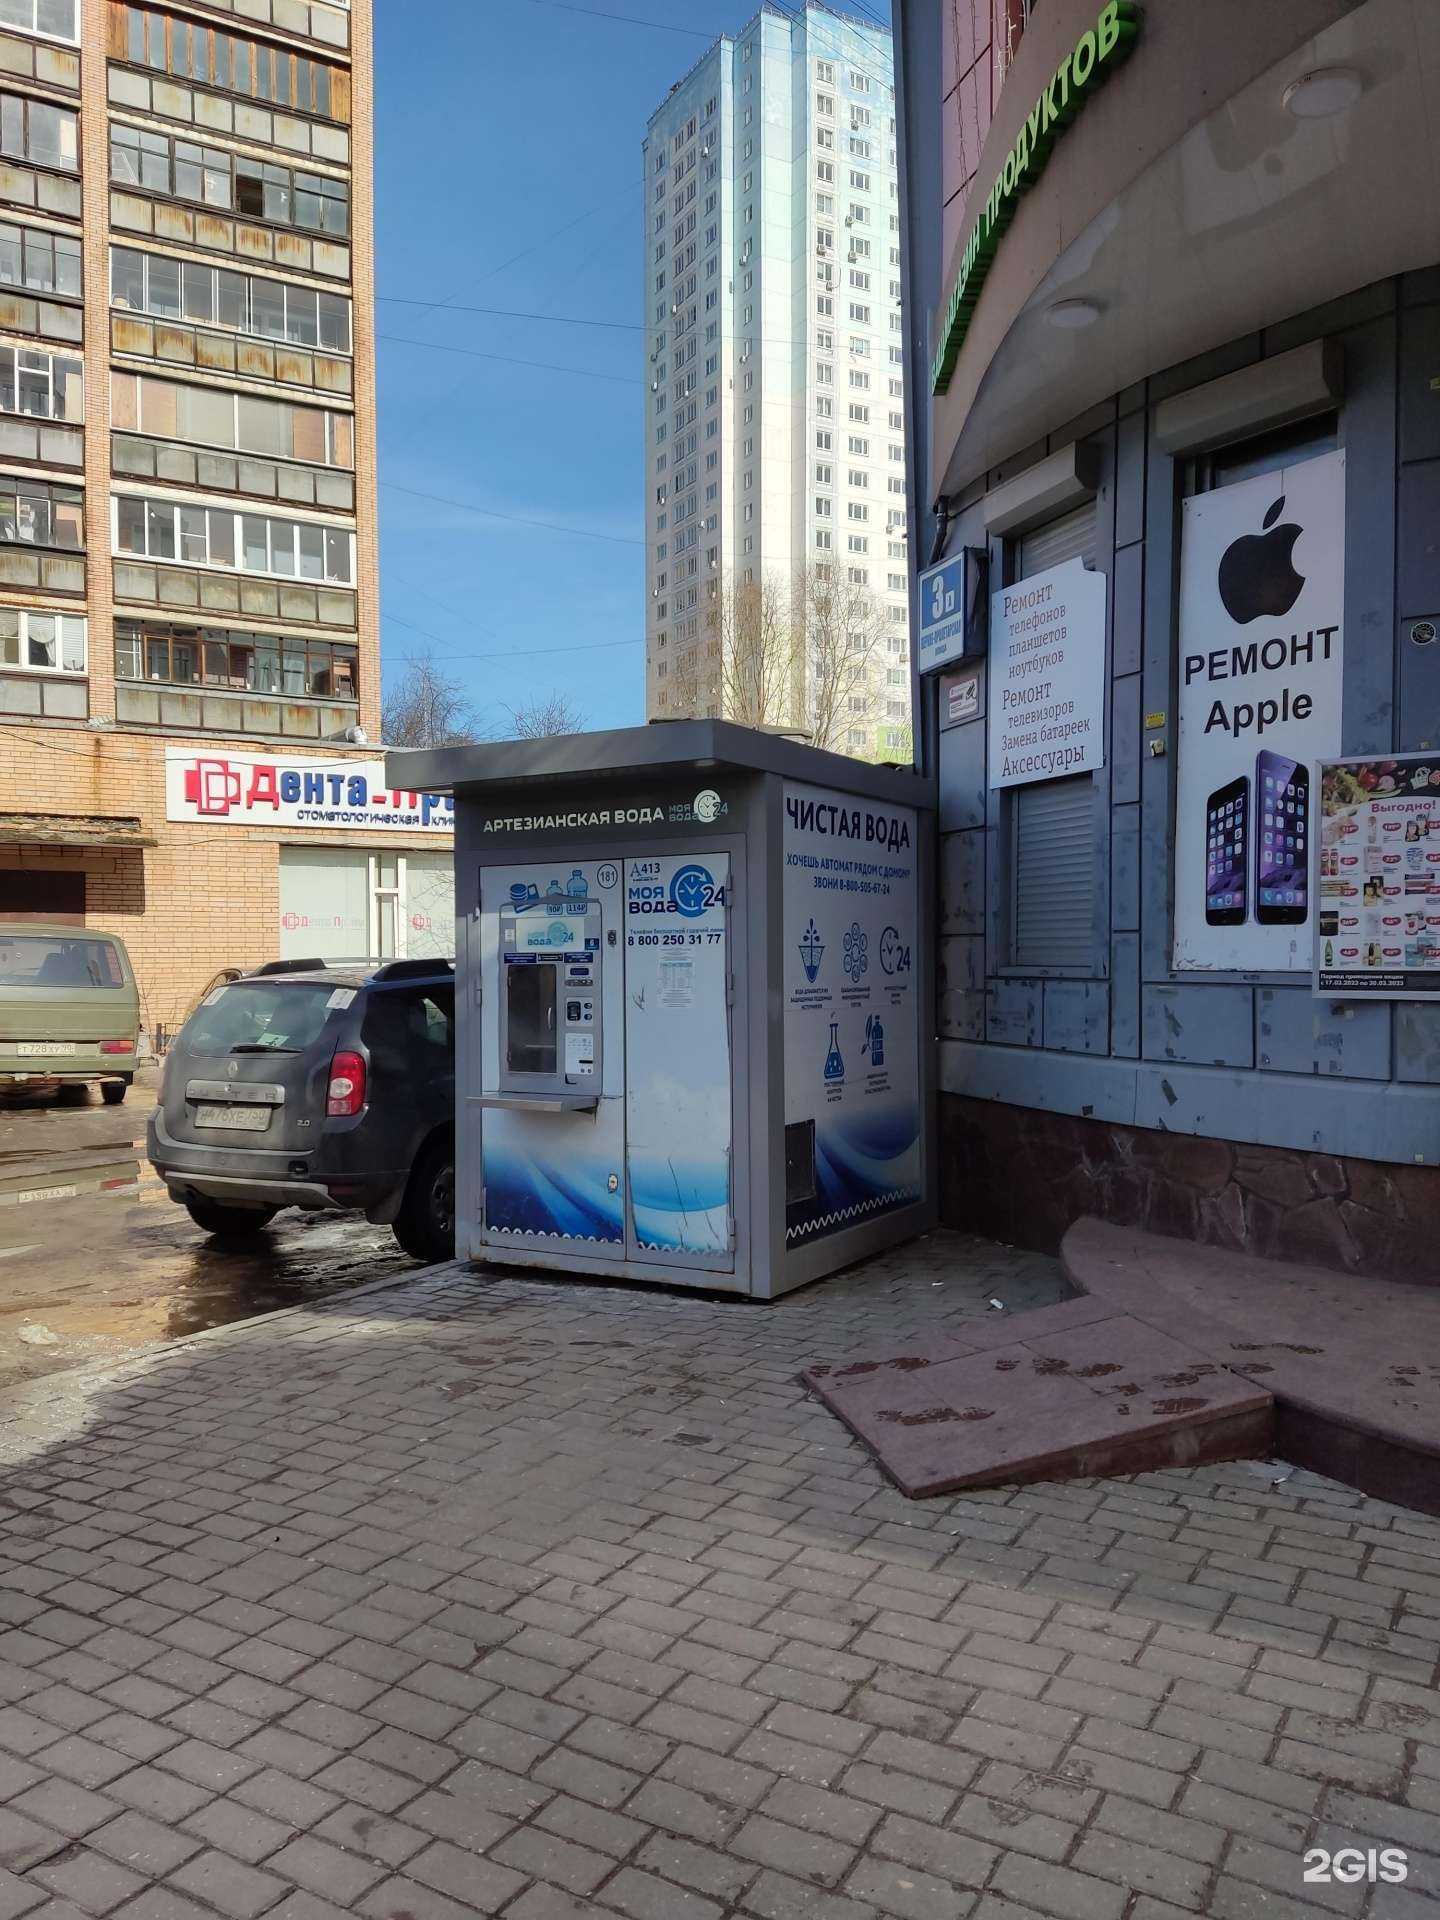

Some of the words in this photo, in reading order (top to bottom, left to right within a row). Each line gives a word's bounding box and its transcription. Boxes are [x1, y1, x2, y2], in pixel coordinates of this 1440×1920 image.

[985, 0, 1123, 238] ПРОДУКТОВ
[1003, 584, 1054, 618] Ремонт
[1008, 604, 1066, 636] телефонов
[1008, 626, 1068, 657] планшетов
[1184, 625, 1339, 686] РЕМОНТ
[1008, 649, 1065, 679] ноутбуков
[1002, 682, 1052, 710] Ремонт
[1008, 701, 1074, 729] телевизоров
[1203, 688, 1313, 738] Apple
[1002, 731, 1038, 751] Замена
[1040, 718, 1091, 741] батареек
[1002, 745, 1085, 778] Аксессуары
[296, 809, 420, 826] стоматологическая
[482, 811, 610, 833] АРТЕЗИАНСКАЯ
[613, 807, 665, 825] ВОДА
[668, 803, 691, 814] МОЯ
[713, 801, 729, 817] 24
[1371, 799, 1437, 820] Выгодно!
[786, 796, 861, 840] ЧИСТАЯ
[865, 813, 910, 853] ВОДА
[599, 870, 617, 883] 181
[786, 852, 820, 869] ХОЧЕШЬ
[820, 858, 853, 873] АВТОМАТ
[853, 861, 878, 877] РЯДОМ
[878, 865, 883, 877] С
[628, 886, 664, 899] МОЯ
[703, 885, 725, 908] 24
[813, 876, 839, 890] ЗВОНИ
[627, 936, 635, 945] 8
[638, 935, 659, 945] 800
[662, 934, 685, 945] 250
[688, 934, 702, 945] 31
[706, 933, 722, 945] 77
[895, 945, 912, 972] 24
